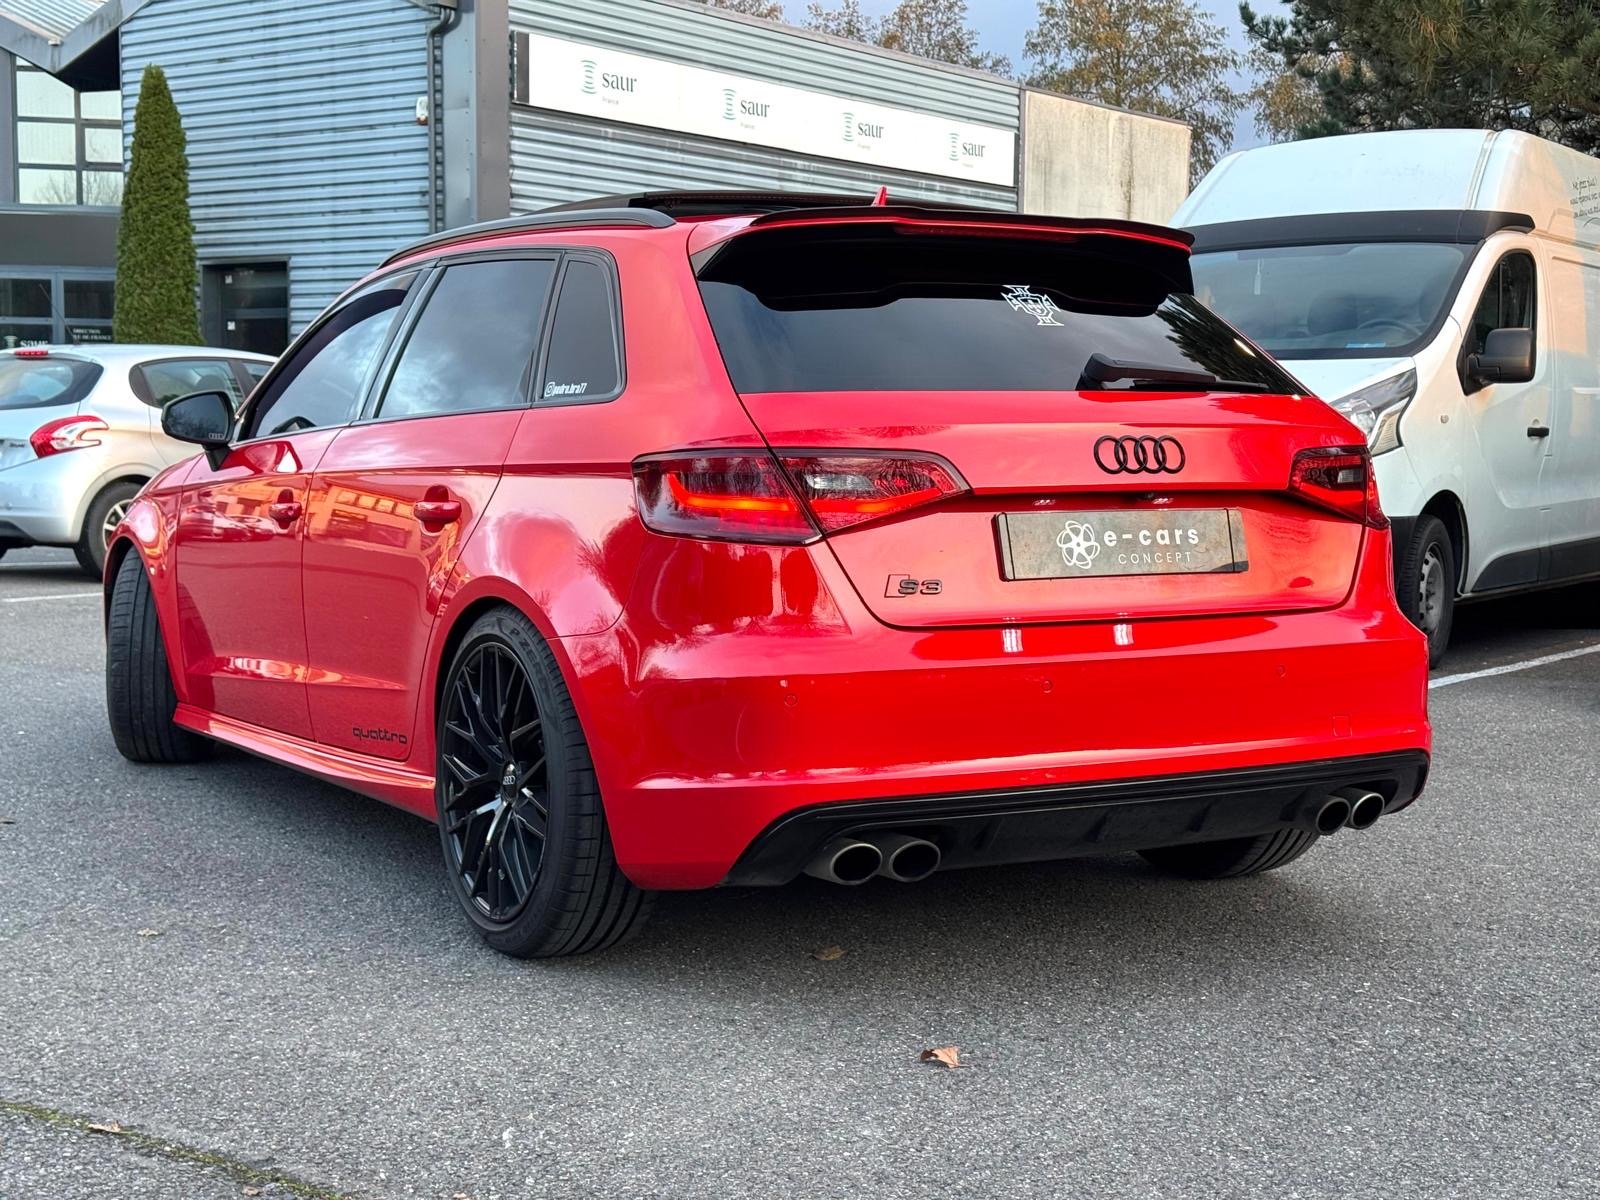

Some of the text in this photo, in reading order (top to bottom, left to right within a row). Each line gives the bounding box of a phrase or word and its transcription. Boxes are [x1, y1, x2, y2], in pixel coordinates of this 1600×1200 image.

[602, 73, 637, 92] saur
[740, 100, 770, 118] saur
[858, 122, 885, 139] saur
[962, 142, 986, 157] saur
[1103, 527, 1200, 547] e-cars
[1118, 552, 1191, 565] CONCEPT
[898, 579, 942, 595] S3
[352, 727, 408, 744] quattro
